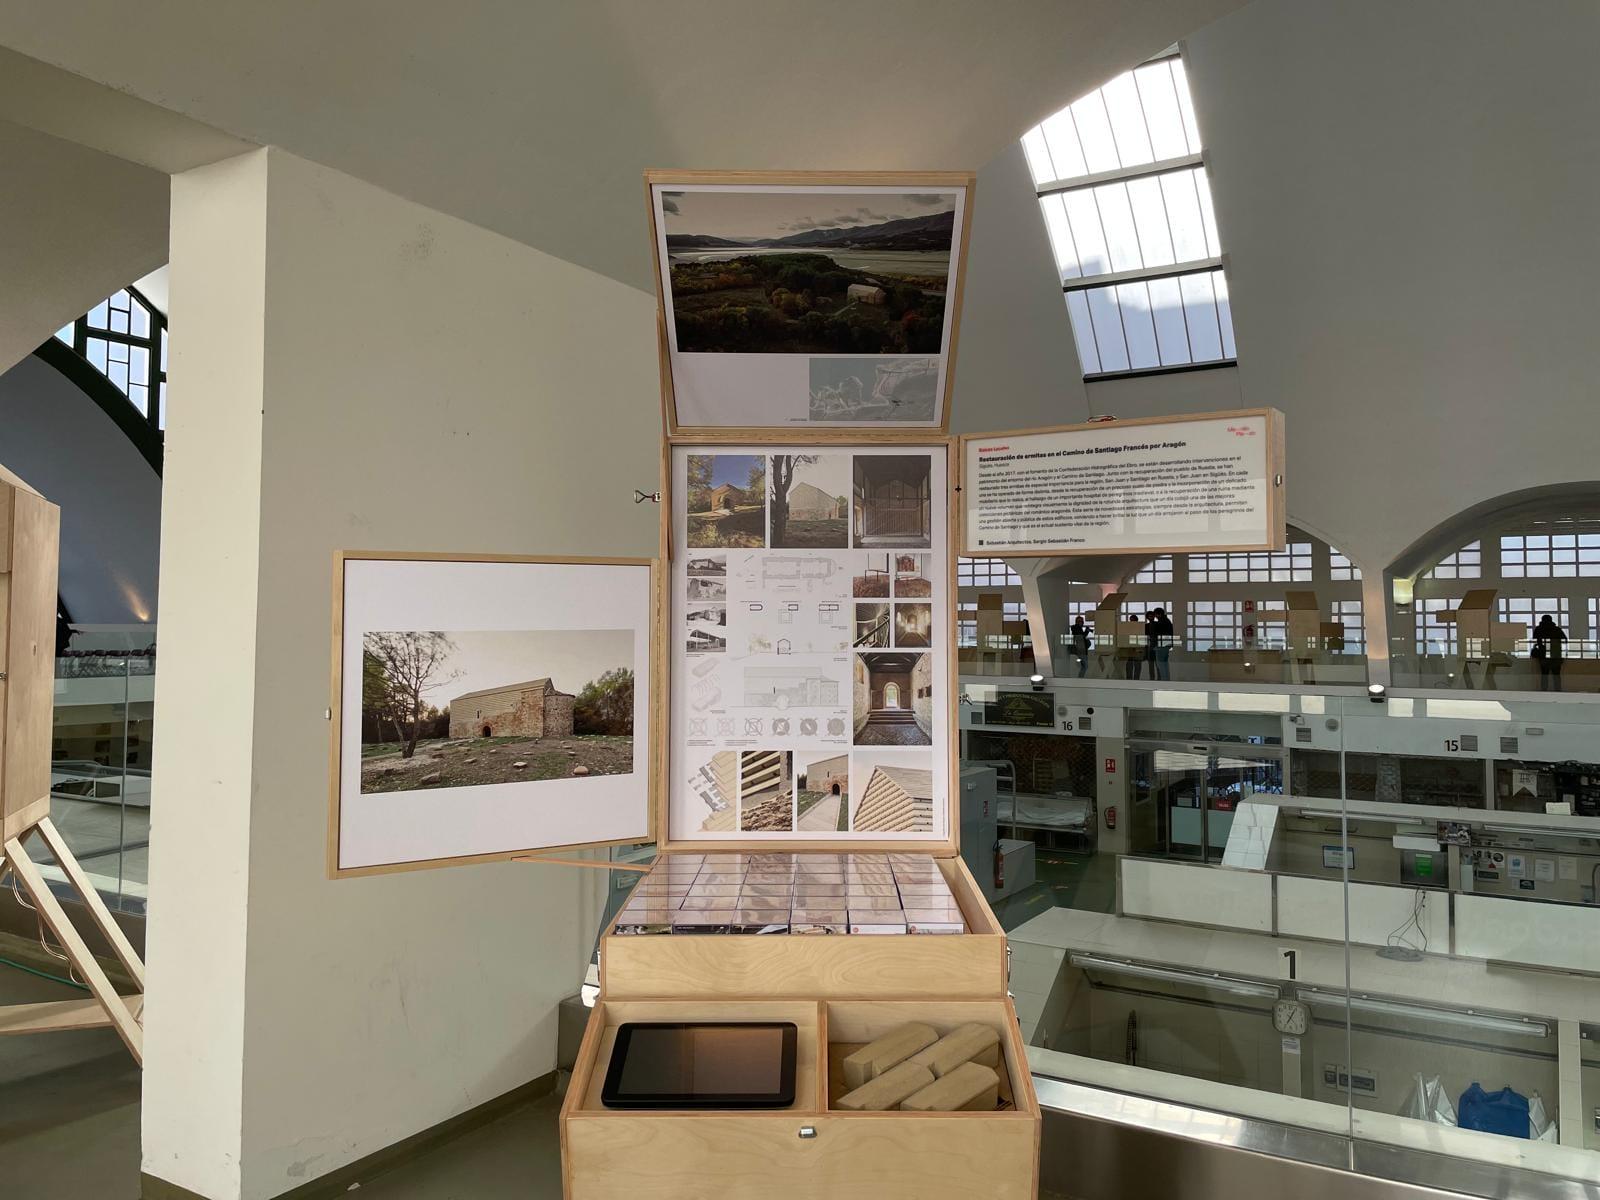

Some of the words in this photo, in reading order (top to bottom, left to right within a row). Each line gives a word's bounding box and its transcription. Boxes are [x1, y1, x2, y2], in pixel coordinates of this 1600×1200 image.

[1094, 446, 1122, 454] Santiago
[1162, 441, 1186, 449] Aragón
[1062, 720, 1073, 731] 16
[1444, 740, 1459, 752] 15
[1283, 950, 1296, 980] 1
